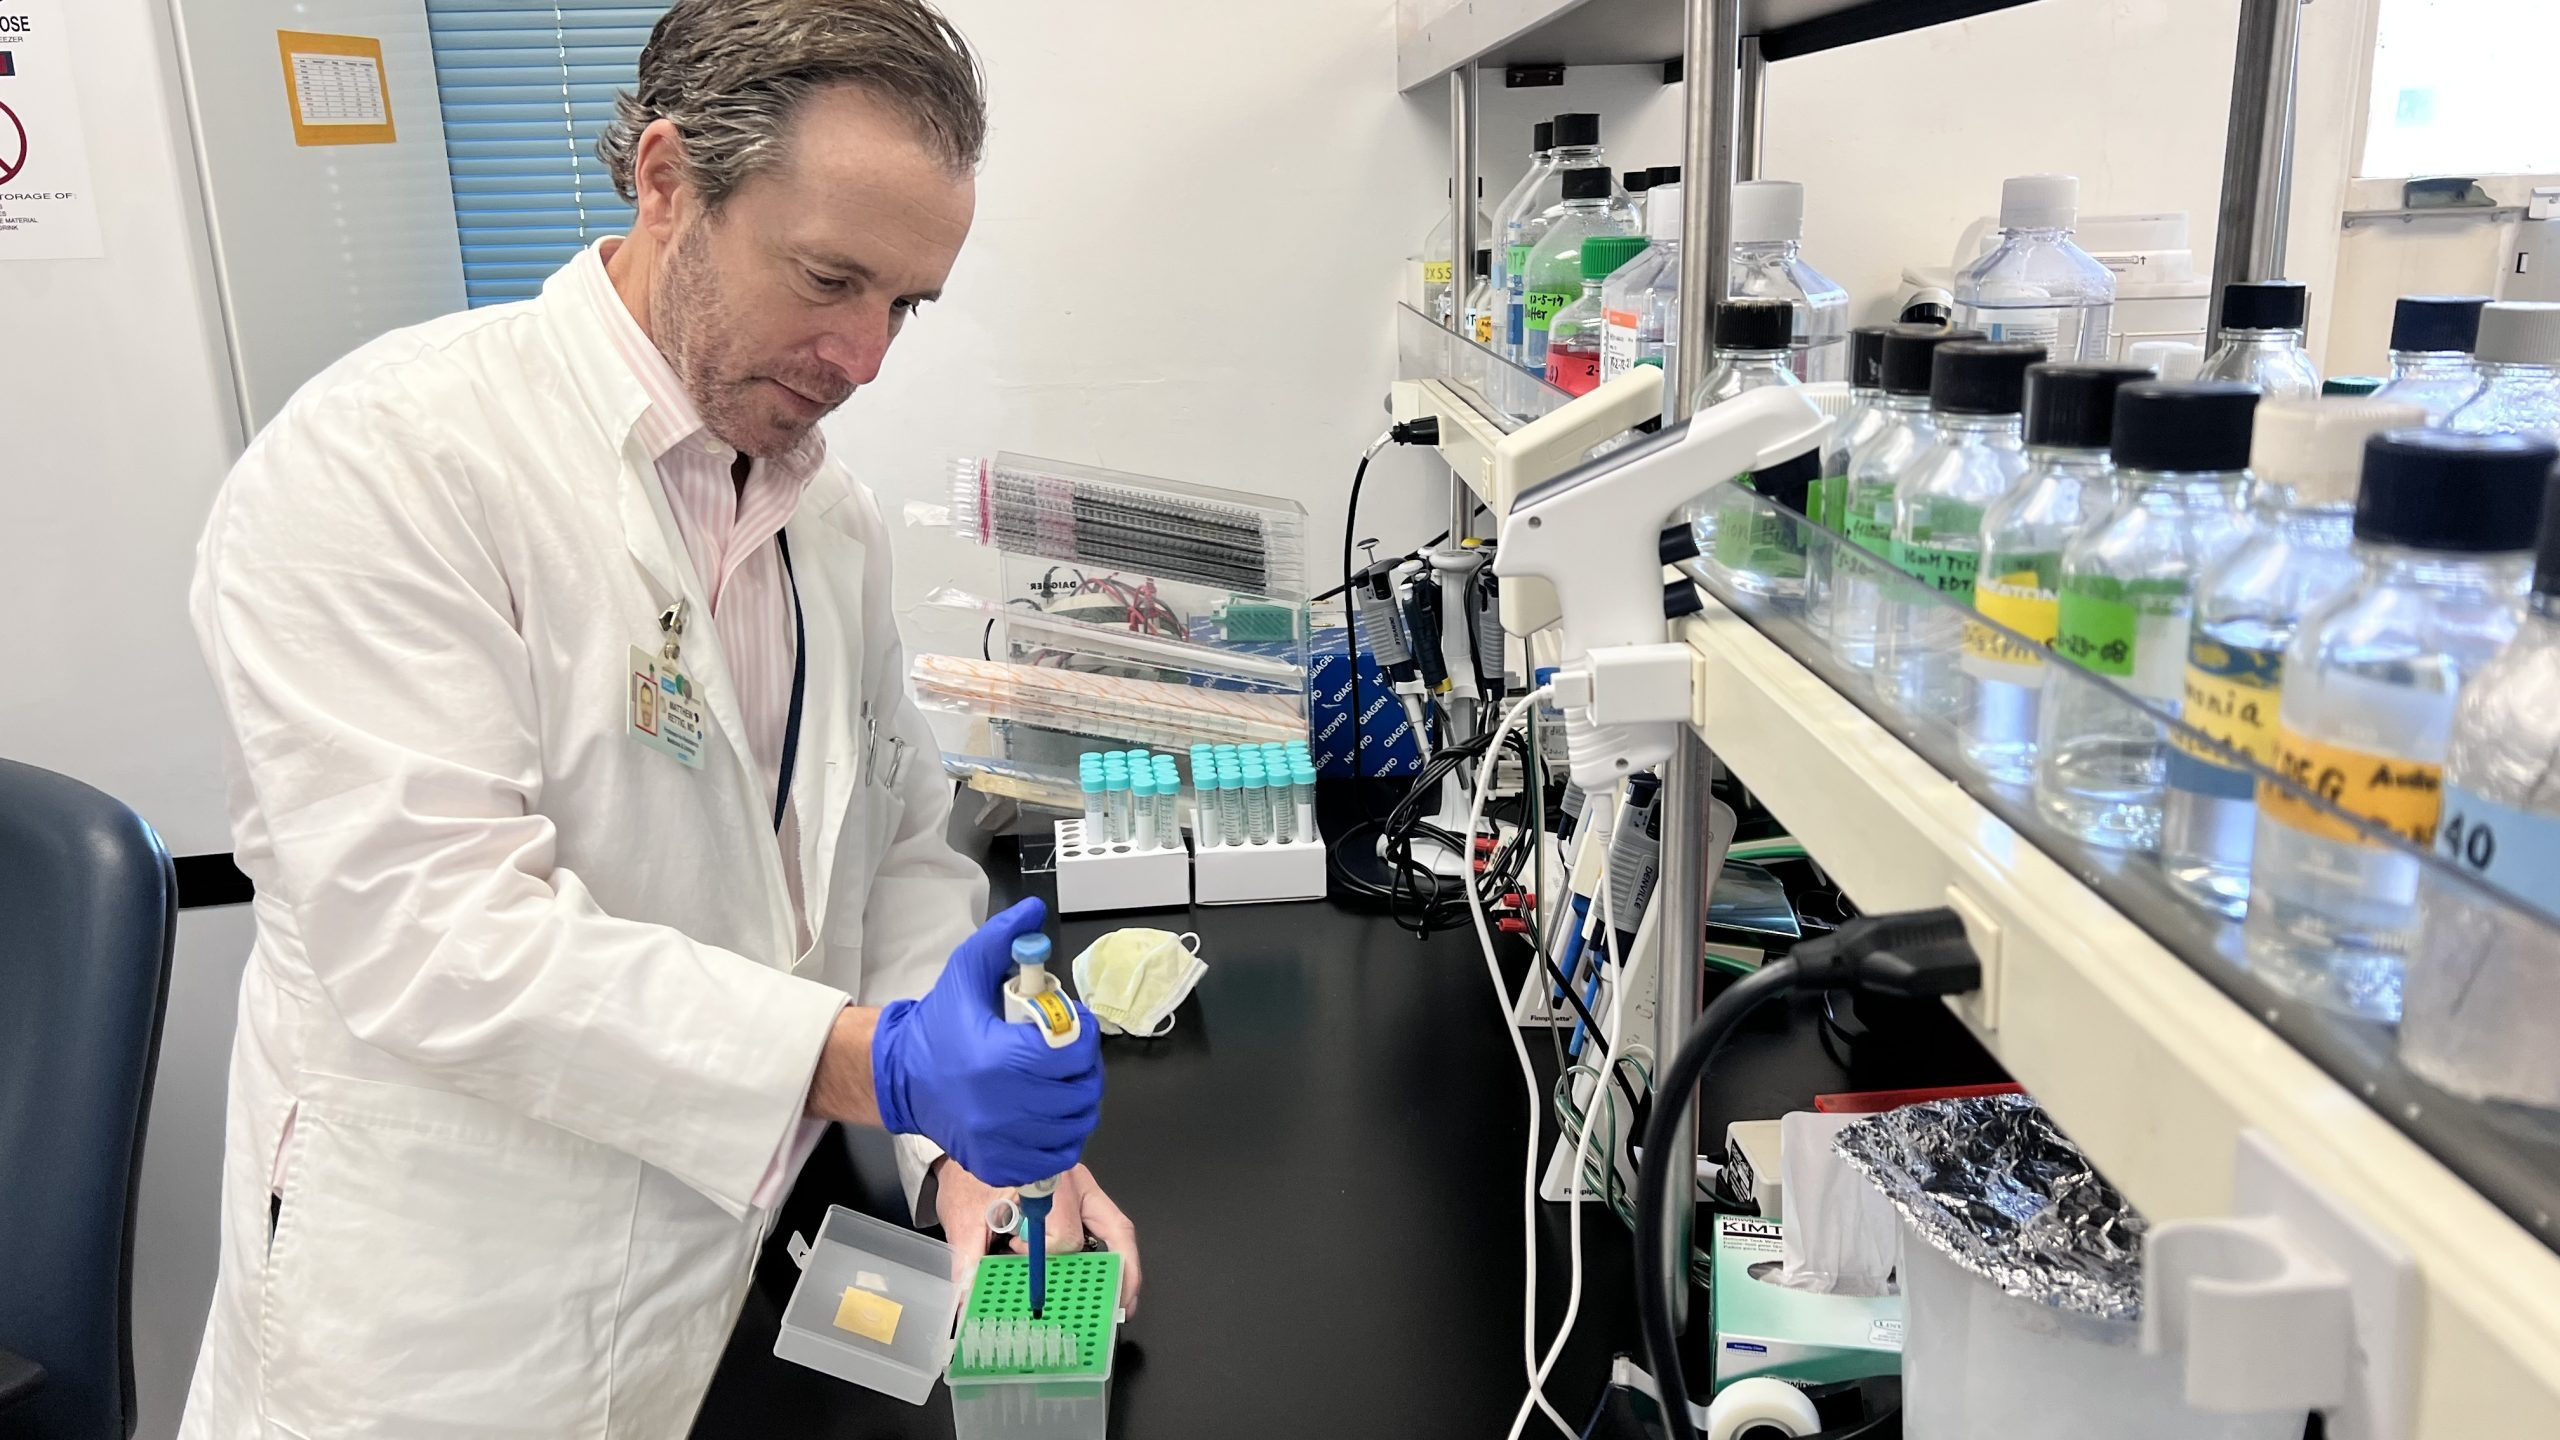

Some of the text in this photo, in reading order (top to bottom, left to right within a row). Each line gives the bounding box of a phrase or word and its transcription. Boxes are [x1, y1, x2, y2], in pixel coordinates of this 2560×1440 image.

[1359, 695, 1389, 725] QIAGEN
[1318, 712, 1348, 742] QIAGEN
[1633, 865, 1653, 910] DENVILLE
